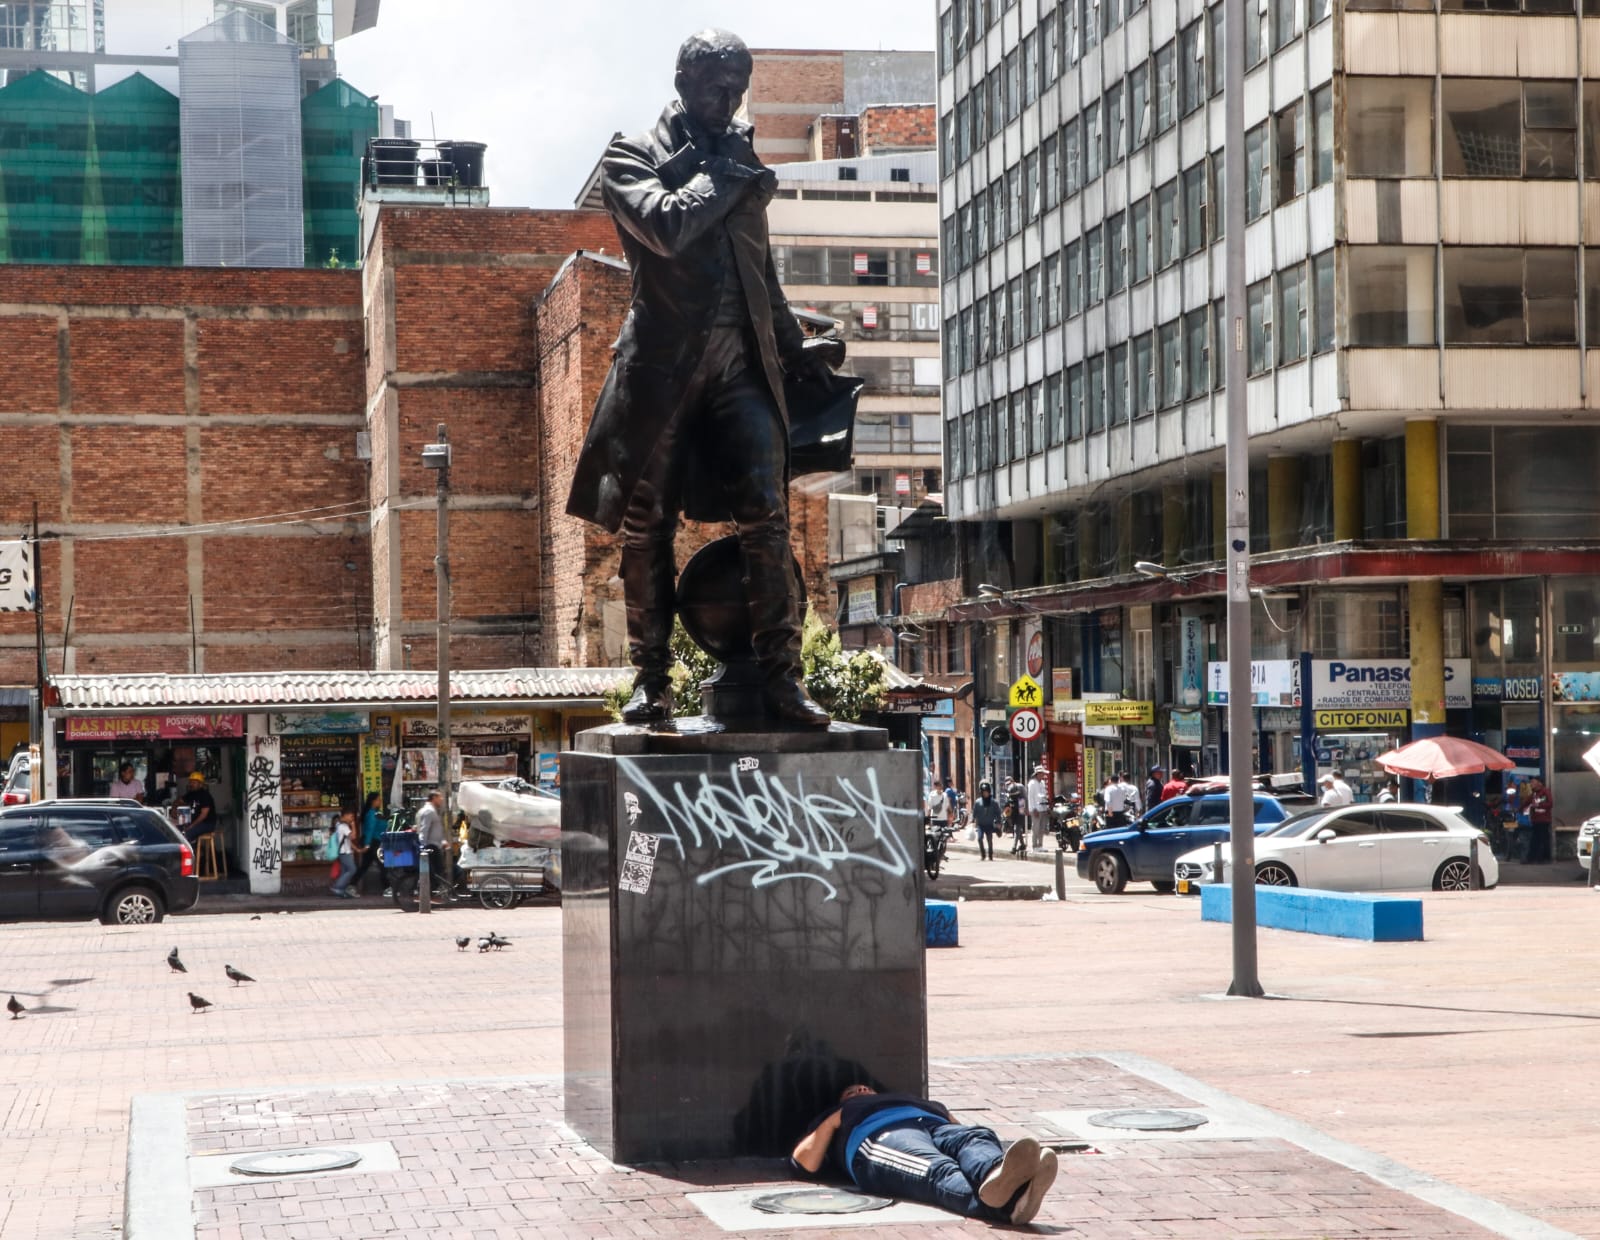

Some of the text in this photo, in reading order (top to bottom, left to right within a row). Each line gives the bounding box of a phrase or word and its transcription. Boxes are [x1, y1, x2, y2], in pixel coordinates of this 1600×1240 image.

[1251, 664, 1266, 685] PIA
[1329, 662, 1454, 682] Panasc
[70, 719, 160, 731] LAS NIEVES
[1015, 717, 1036, 732] 30
[1319, 713, 1404, 725] CITOFONIA
[283, 736, 352, 746] NATURISTA
